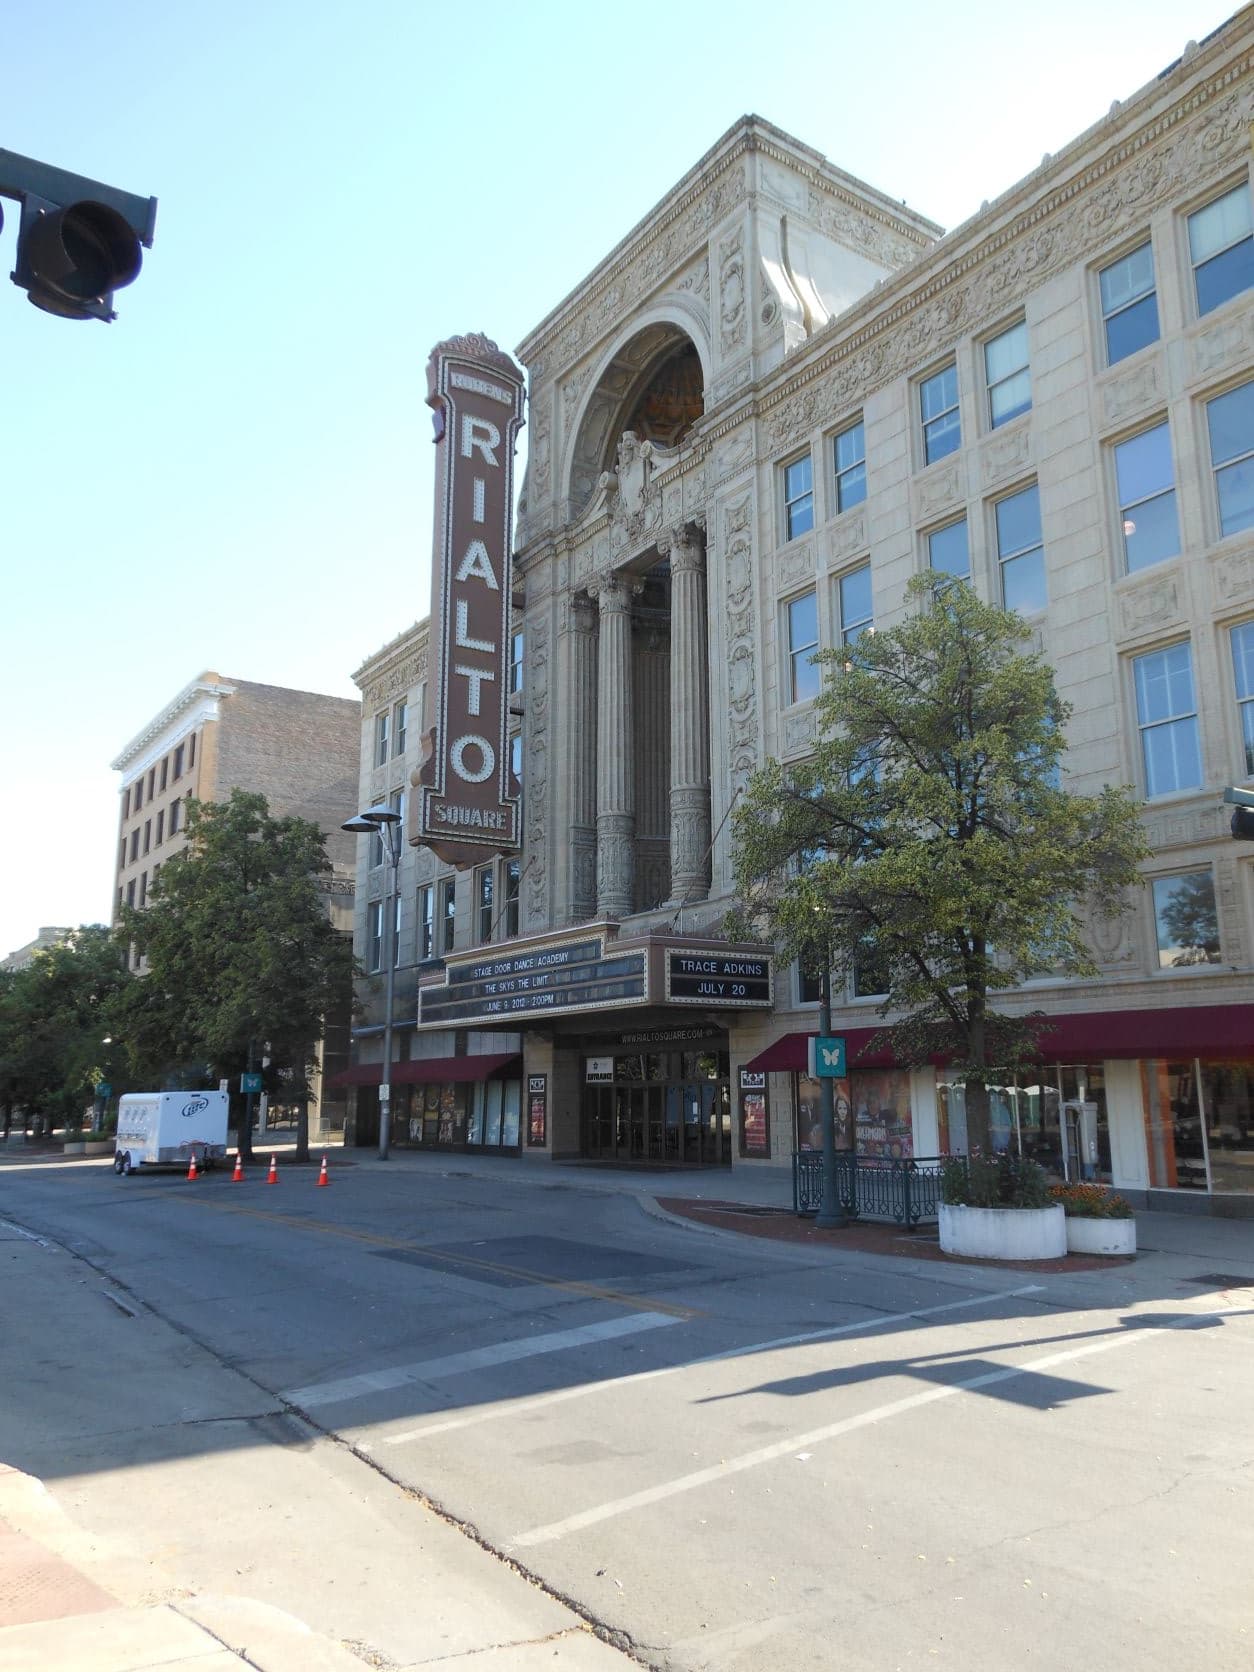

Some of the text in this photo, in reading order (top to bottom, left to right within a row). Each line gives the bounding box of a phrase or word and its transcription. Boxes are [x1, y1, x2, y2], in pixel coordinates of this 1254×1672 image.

[450, 413, 500, 783] RIALTO
[434, 803, 506, 830] SQUARE
[474, 951, 569, 978] STAGE DOOR DANCE ACADEMY
[680, 960, 762, 975] TRACE ADKINS
[485, 975, 549, 994] THE SKYS THE LIMIT
[697, 982, 746, 995] JULY 20
[486, 1001, 500, 1012] JUNE
[512, 998, 525, 1009] 2012
